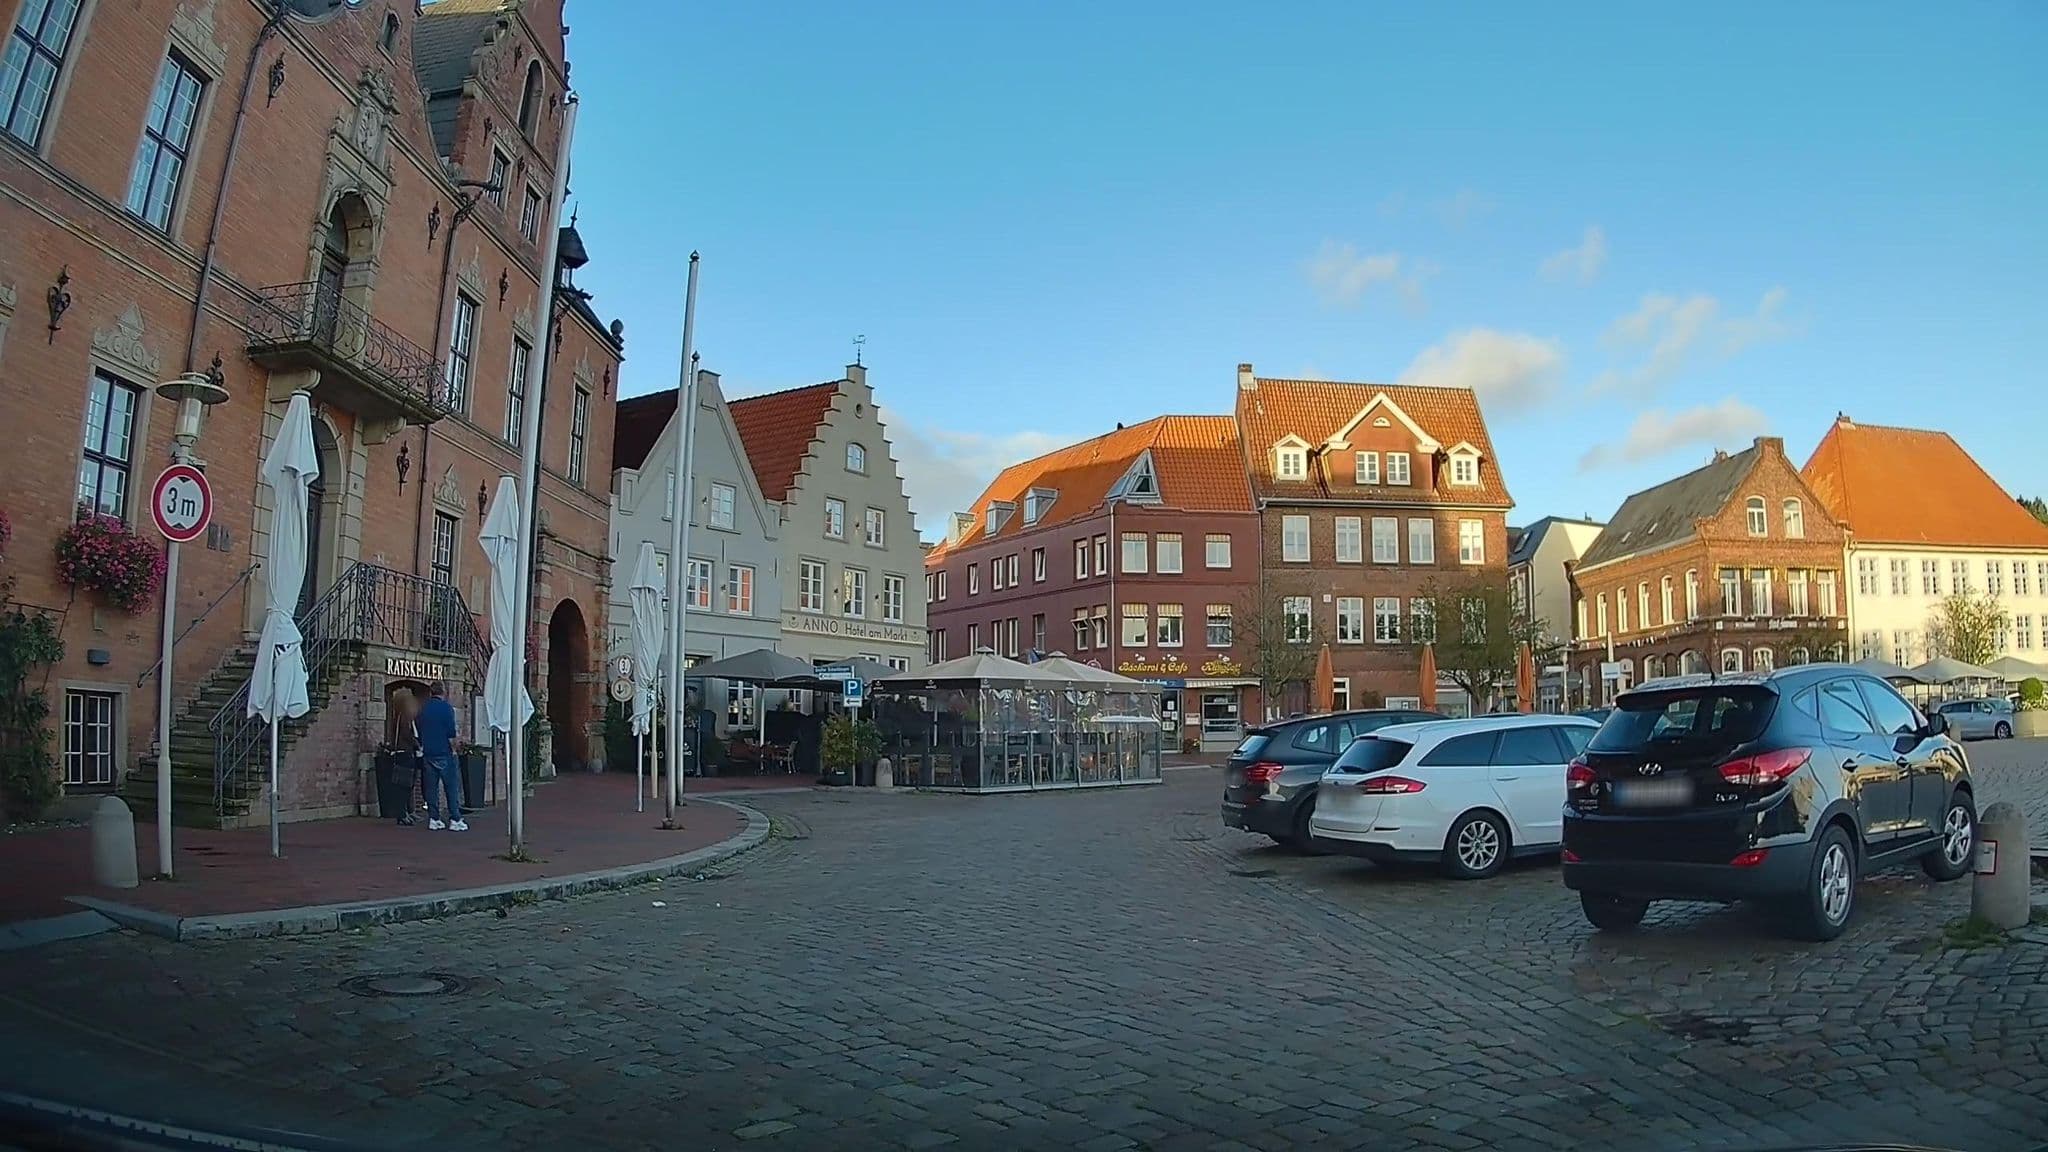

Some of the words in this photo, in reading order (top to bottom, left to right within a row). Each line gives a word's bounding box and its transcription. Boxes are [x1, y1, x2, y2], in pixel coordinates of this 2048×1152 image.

[167, 487, 178, 514] 3
[181, 498, 196, 518] m
[803, 617, 839, 634] ANNO
[845, 622, 867, 637] Hotel
[868, 630, 881, 639] am
[884, 627, 908, 641] Markt
[387, 658, 443, 681] RATSKELLER
[847, 680, 858, 695] P
